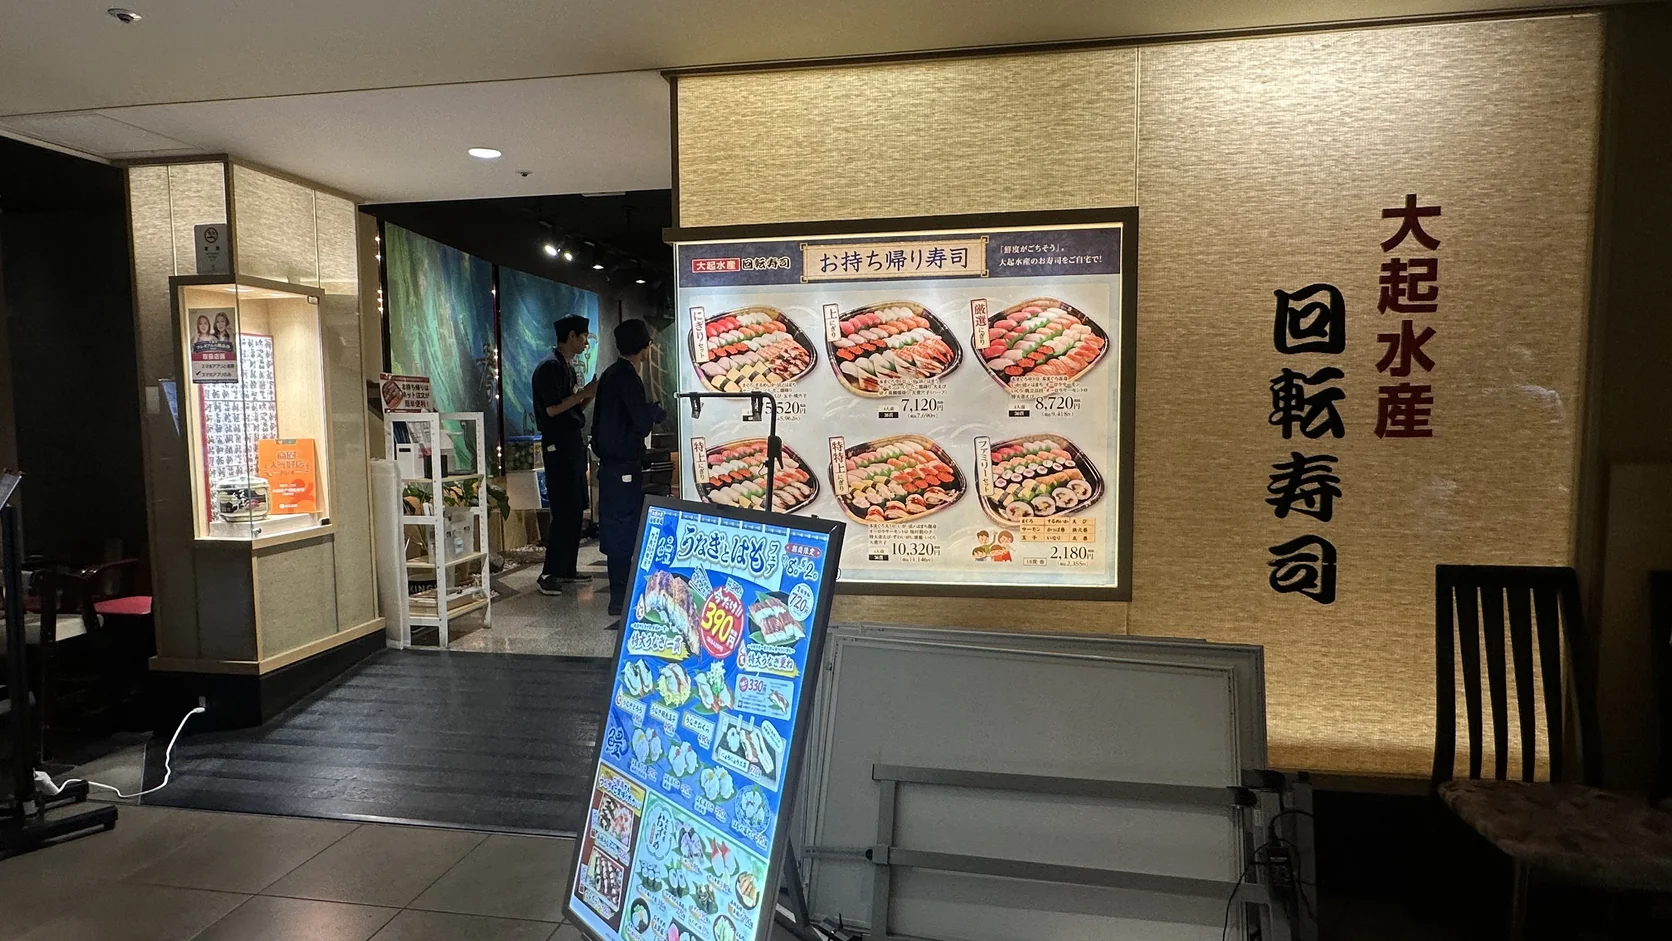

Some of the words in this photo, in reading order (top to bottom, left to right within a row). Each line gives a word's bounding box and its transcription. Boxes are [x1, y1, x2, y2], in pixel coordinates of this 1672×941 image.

[695, 259, 737, 272] 大起水産
[741, 256, 791, 271] 回転寿司
[819, 246, 968, 273] お持ち帰り寿司
[826, 308, 838, 339] 上にぎり
[1373, 193, 1441, 439] 大起水産
[765, 401, 806, 414] 5520円
[693, 441, 706, 481] 特上にぎり
[1264, 282, 1347, 604] 回転寿司
[831, 441, 846, 492] 特特上にぎり
[978, 440, 990, 493] ファミリーセット
